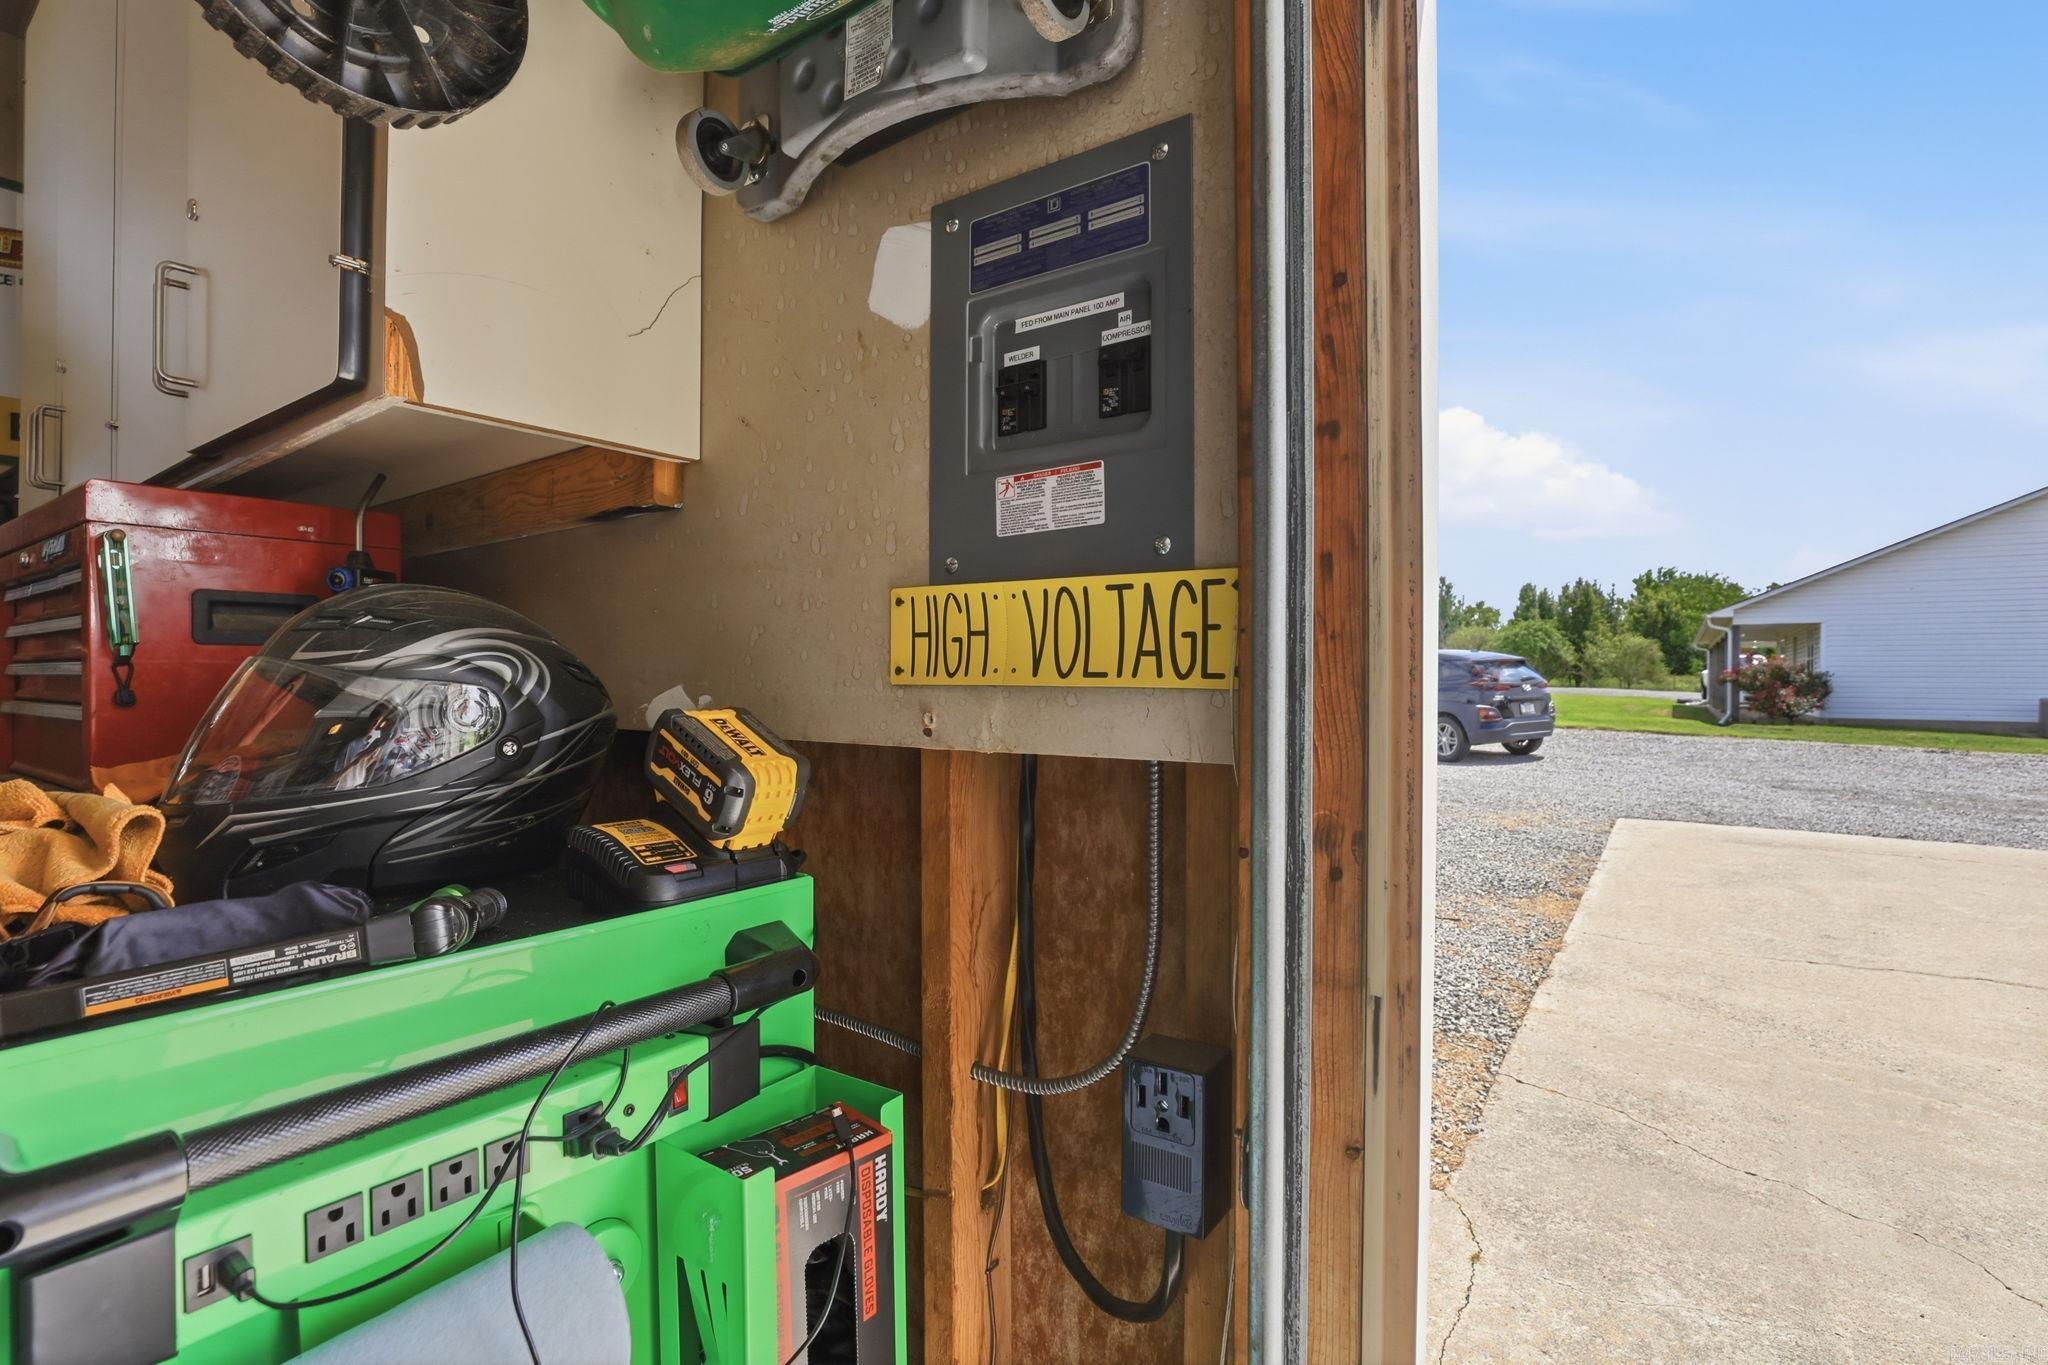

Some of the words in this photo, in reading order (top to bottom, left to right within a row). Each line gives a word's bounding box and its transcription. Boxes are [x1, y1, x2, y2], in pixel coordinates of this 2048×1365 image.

[1021, 319, 1034, 328] FED
[1034, 315, 1053, 325] FROM
[1053, 311, 1070, 321] MAIN
[1070, 306, 1092, 316] PANEL
[1093, 302, 1104, 310] 100
[1105, 297, 1120, 308] AMP
[1119, 314, 1132, 323] AIR
[1102, 324, 1151, 342] COMPRESSOR
[1008, 351, 1034, 362] WELDER
[910, 591, 990, 678] HIGH
[1022, 578, 1226, 681] VOLTAGE
[703, 788, 714, 805] 6
[303, 949, 358, 968] BRAUN
[874, 1153, 888, 1223] HARDY
[859, 1166, 873, 1256] DISPOSABLE
[863, 1257, 877, 1316] GLOVES
